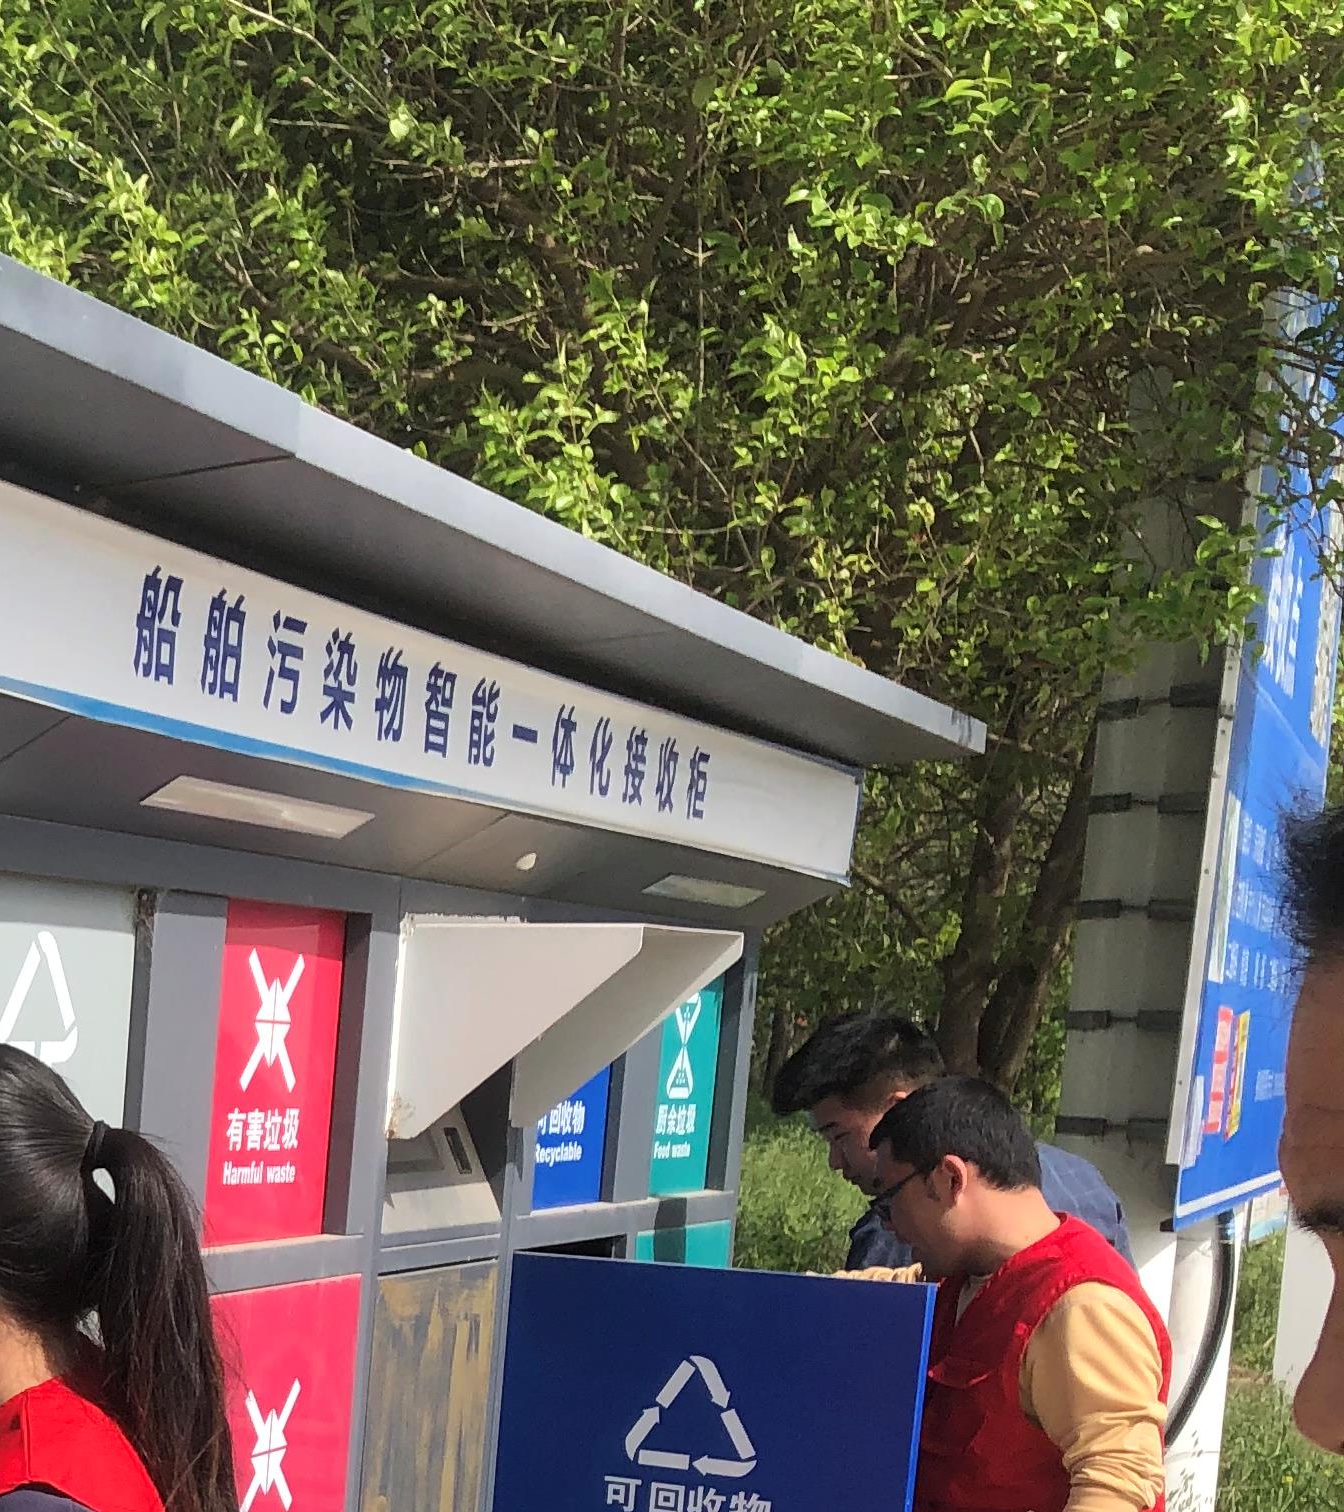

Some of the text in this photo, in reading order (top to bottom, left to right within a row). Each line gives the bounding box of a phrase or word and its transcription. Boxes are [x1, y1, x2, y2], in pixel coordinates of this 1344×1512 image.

[227, 1107, 300, 1152] 有害垃圾
[656, 1104, 696, 1135] 厨余垃圾
[223, 1160, 296, 1185] Harmful waste
